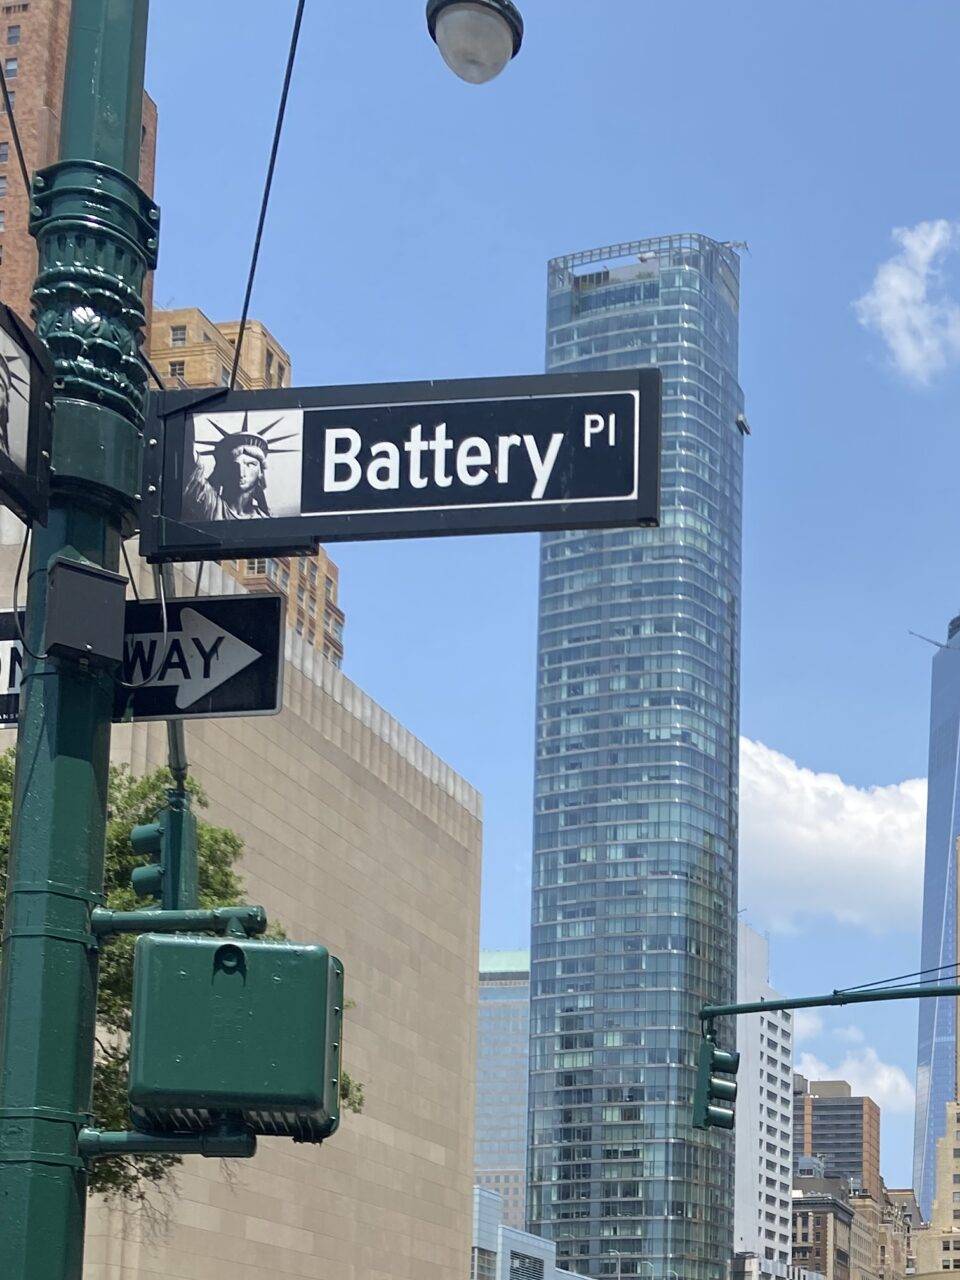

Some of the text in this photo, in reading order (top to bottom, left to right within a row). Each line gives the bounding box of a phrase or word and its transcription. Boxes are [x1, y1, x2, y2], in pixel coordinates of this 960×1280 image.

[323, 413, 617, 499] Battery Pl
[123, 636, 226, 684] WAY
